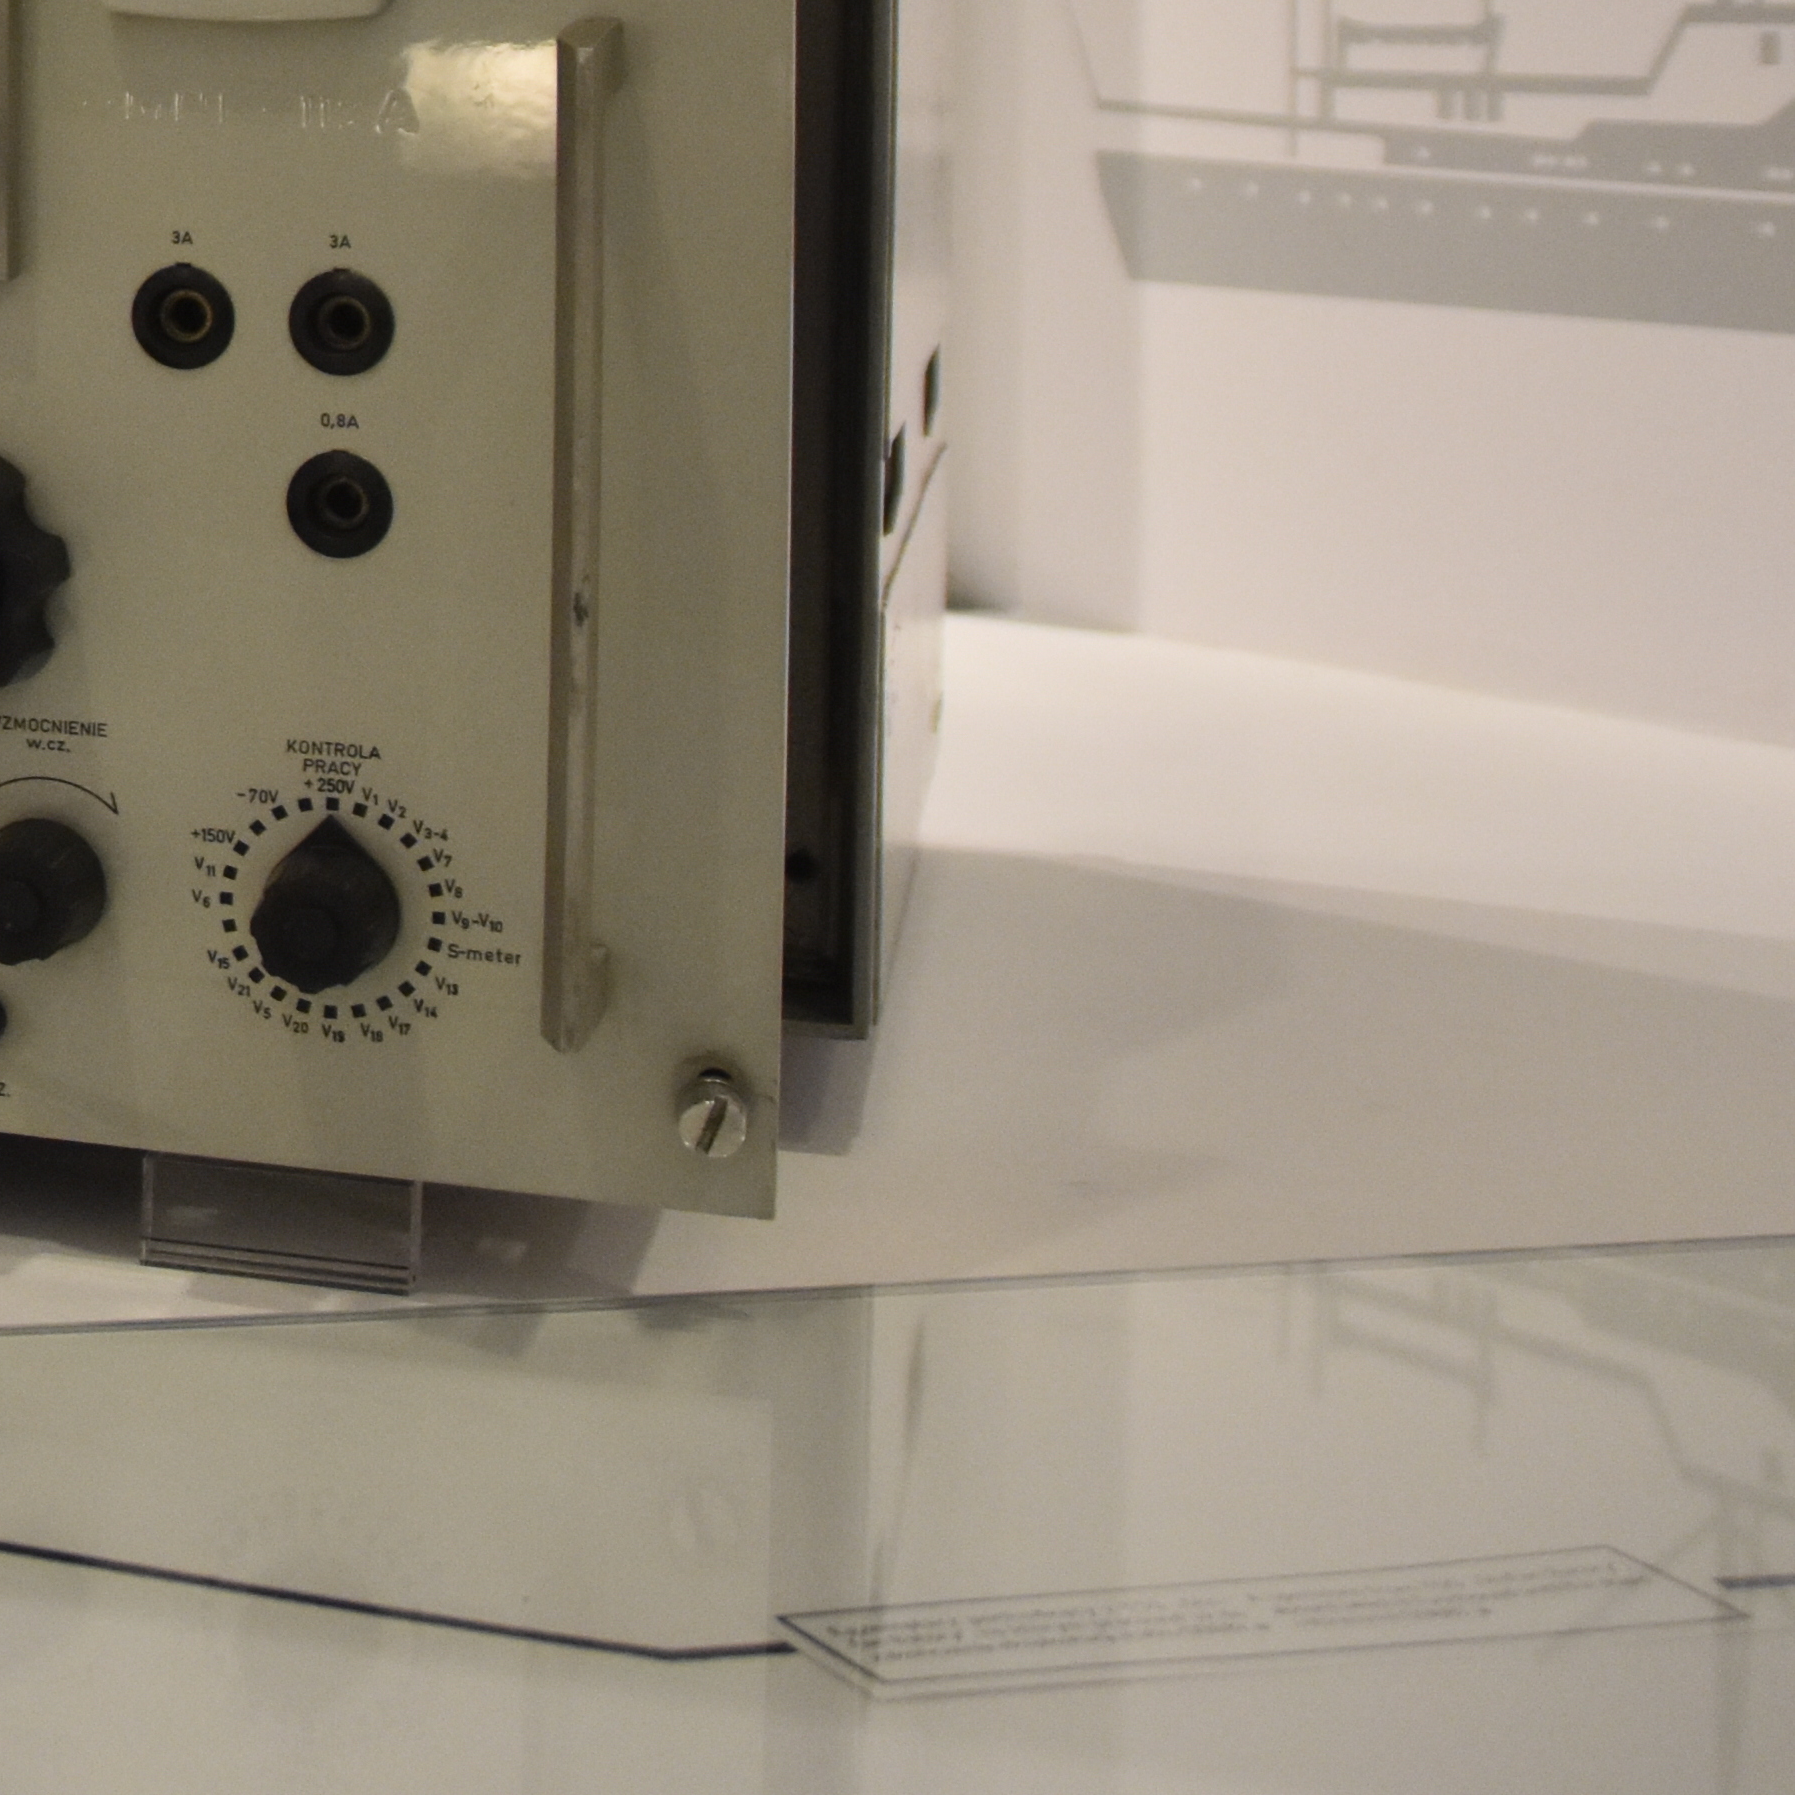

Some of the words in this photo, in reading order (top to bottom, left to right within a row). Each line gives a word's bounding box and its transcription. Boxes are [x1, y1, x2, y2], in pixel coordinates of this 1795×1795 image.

[171, 230, 194, 246] 3A
[329, 234, 352, 249] 3A
[319, 413, 360, 431] 0,8A
[286, 738, 382, 760] KONTROLA
[302, 758, 363, 777] PRACY
[447, 943, 522, 966] S-meter
